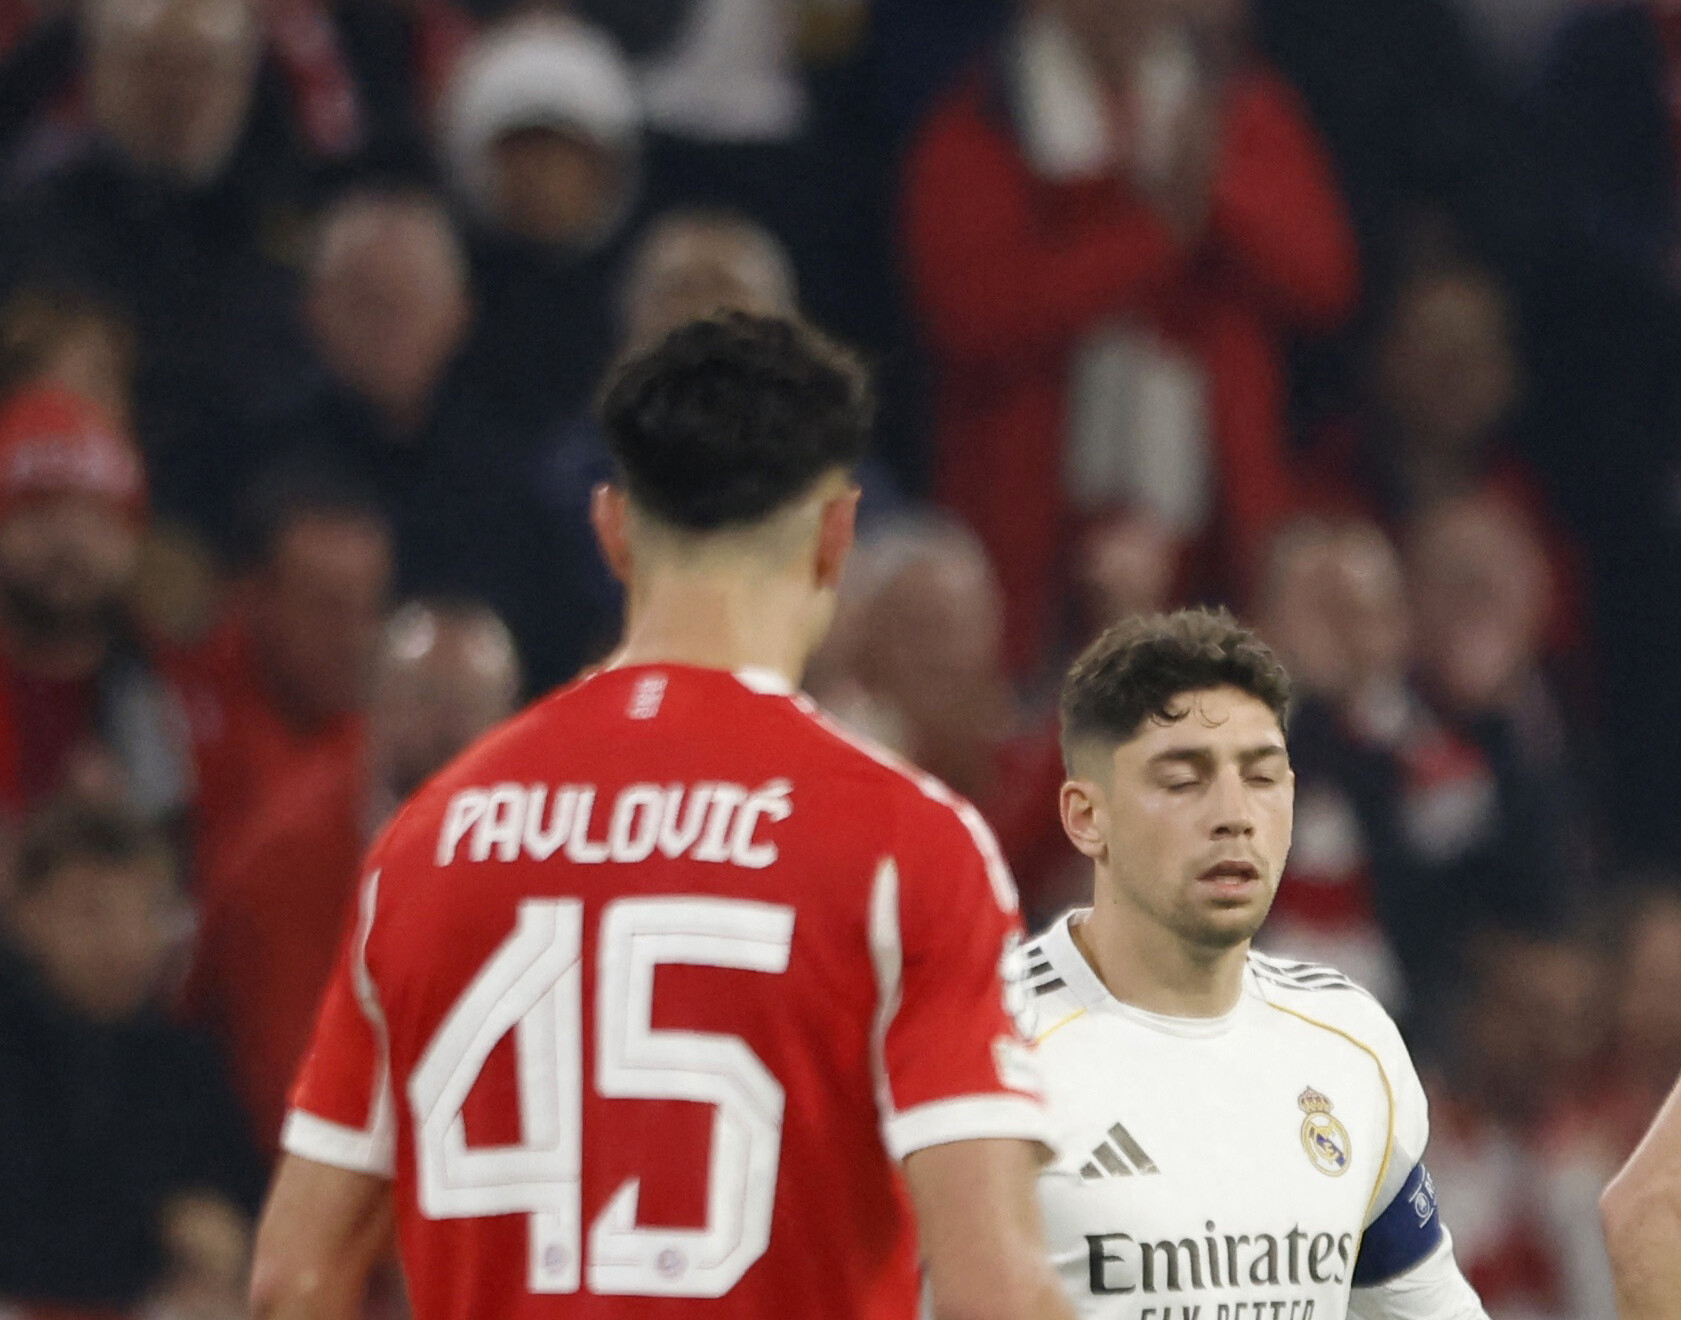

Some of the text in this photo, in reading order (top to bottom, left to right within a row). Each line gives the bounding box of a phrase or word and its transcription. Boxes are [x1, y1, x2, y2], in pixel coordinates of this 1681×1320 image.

[436, 777, 795, 869] PAVLOVIĆ
[407, 895, 797, 1299] 45
[1085, 1220, 1353, 1296] Emirates
